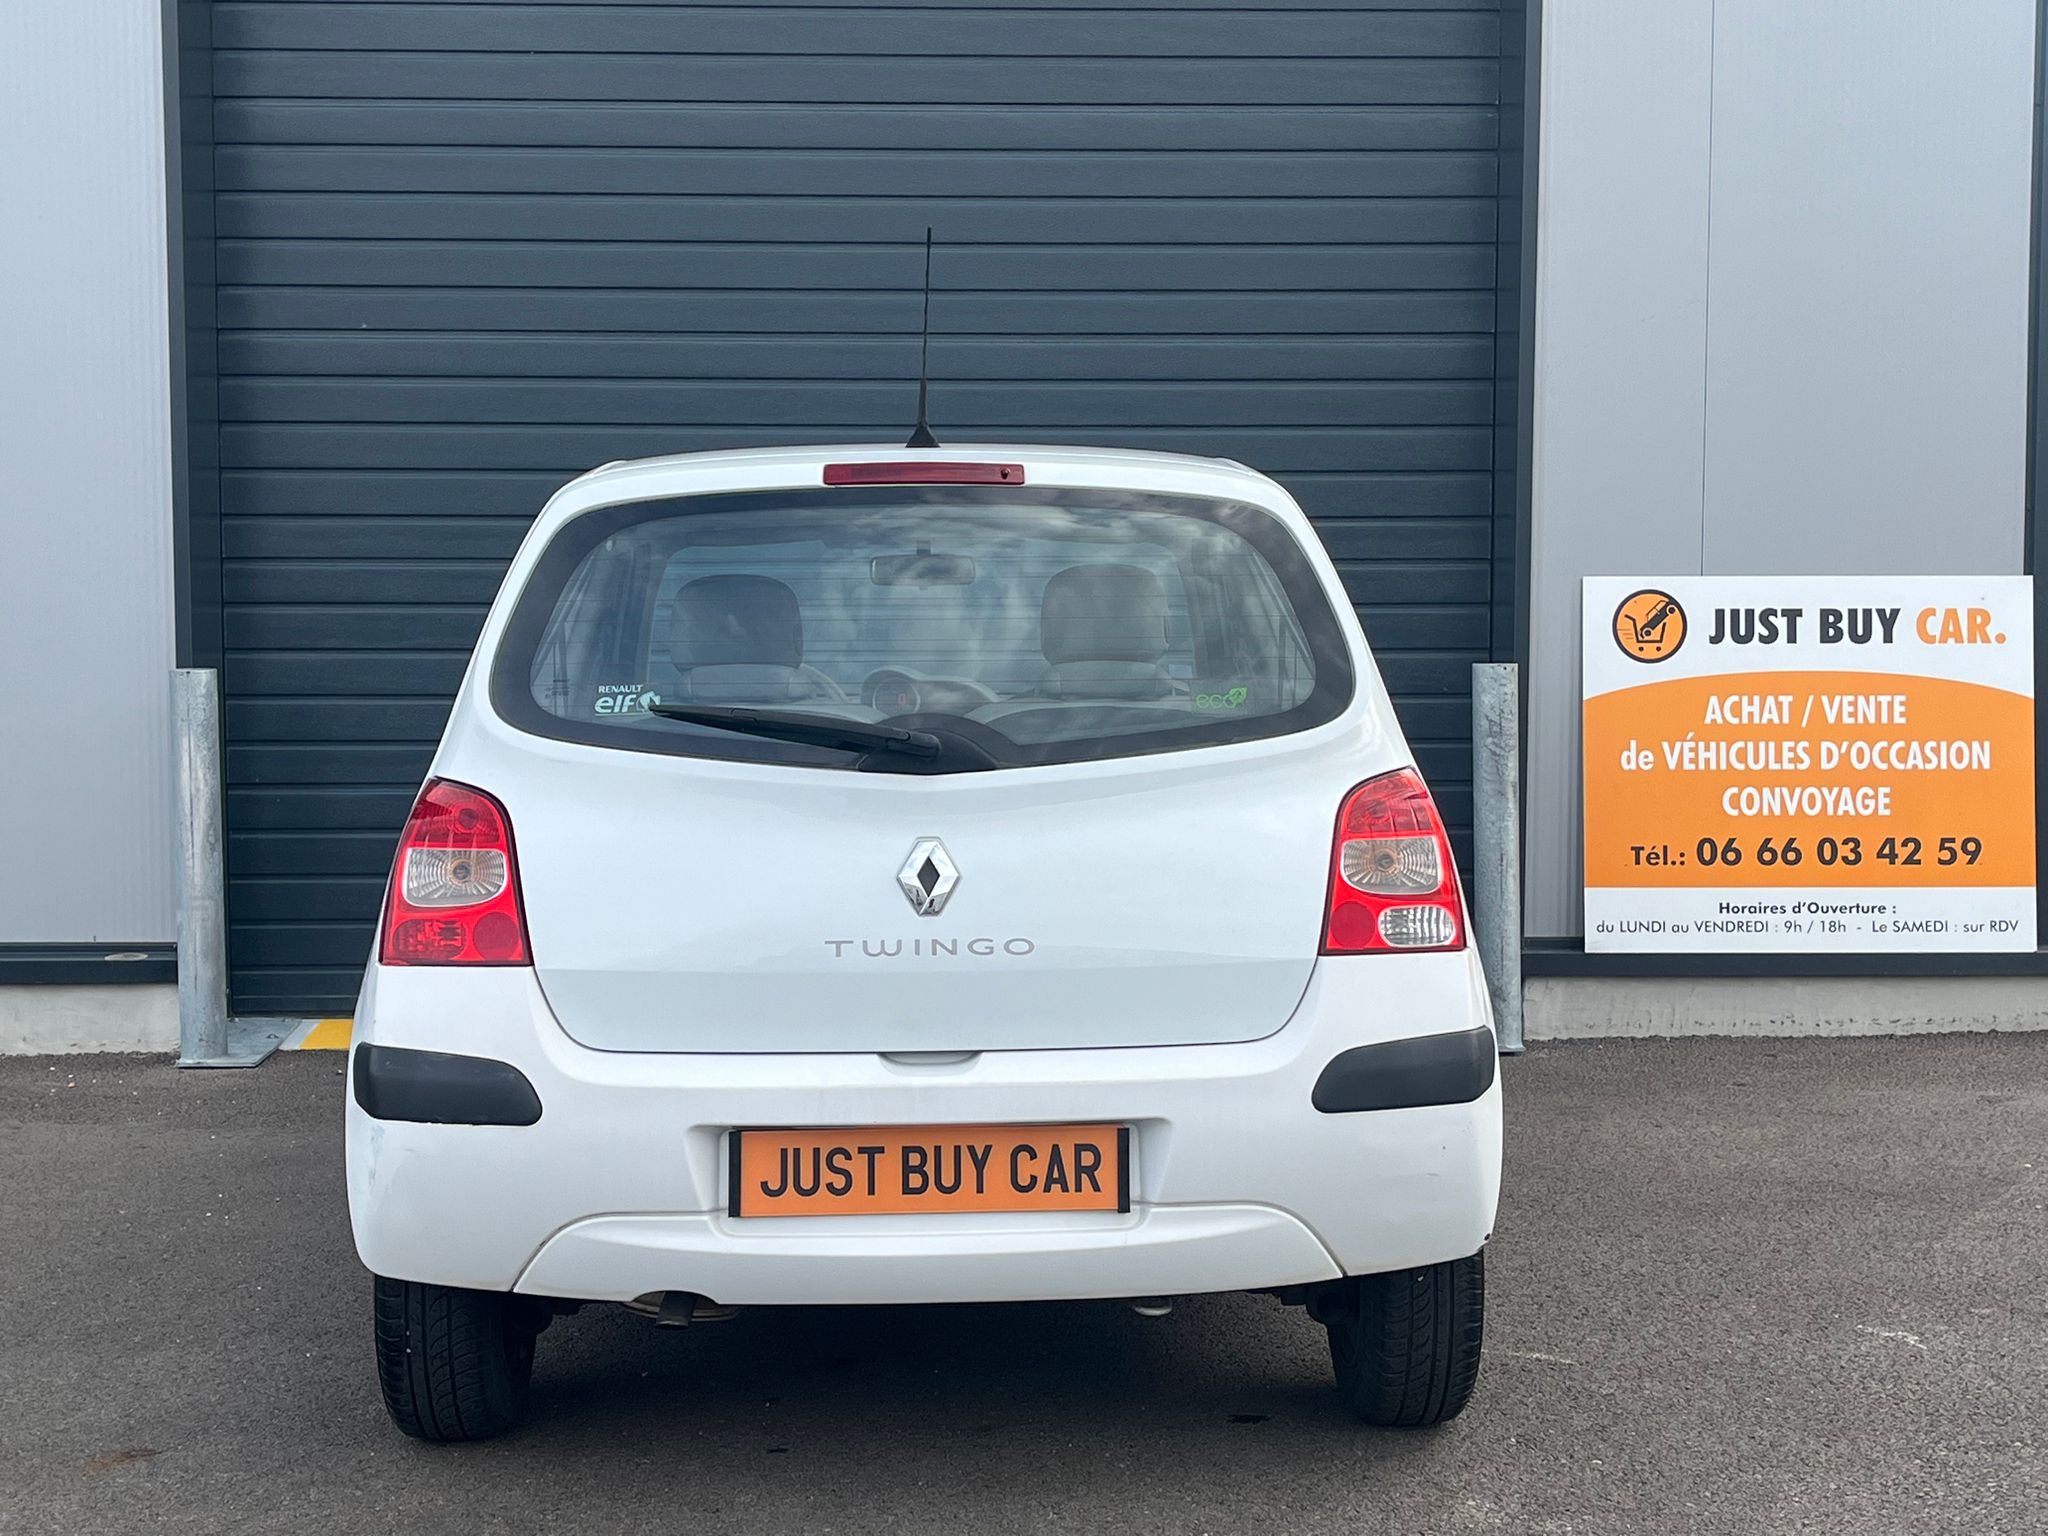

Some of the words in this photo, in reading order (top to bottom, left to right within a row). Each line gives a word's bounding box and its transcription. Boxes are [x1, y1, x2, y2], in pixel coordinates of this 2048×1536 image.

[1709, 608, 1802, 645] JUST
[1819, 608, 1901, 644] BUY
[1915, 607, 2007, 645] CAR.
[594, 694, 636, 713] elf
[598, 685, 643, 693] RENAULT
[1704, 695, 1793, 725] ACHAT
[1801, 696, 1812, 727] /
[1822, 695, 1907, 724] VENTE
[1620, 740, 1654, 770] de
[1662, 732, 1811, 771] VÉHICULES
[1820, 740, 1991, 770] D'OCCASION
[1722, 786, 1891, 816] CONVOYAGE
[1630, 844, 1686, 866] Tél.:
[1696, 837, 1742, 866] 06
[1756, 837, 1803, 866] 66
[1816, 837, 1862, 866] 03
[1876, 837, 1922, 866] 42
[1937, 837, 1983, 866] 59
[1718, 902, 1786, 914] Horaires
[1596, 920, 1614, 933] du
[1619, 921, 1666, 933] LUNDI
[1671, 924, 1689, 933] au
[1694, 921, 1769, 933] VENDREDI
[1784, 920, 1802, 933] 9h
[1806, 921, 1814, 934] /
[1819, 920, 1847, 933] 18h
[1871, 921, 1888, 933] Le
[1892, 920, 1948, 933] SAMEDI
[1963, 924, 1985, 933] sur
[1989, 920, 2019, 933] RDV
[824, 937, 1035, 958] TWINGO
[760, 1146, 885, 1197] JUST
[901, 1144, 993, 1195] BUY
[1009, 1143, 1102, 1193] CAR
